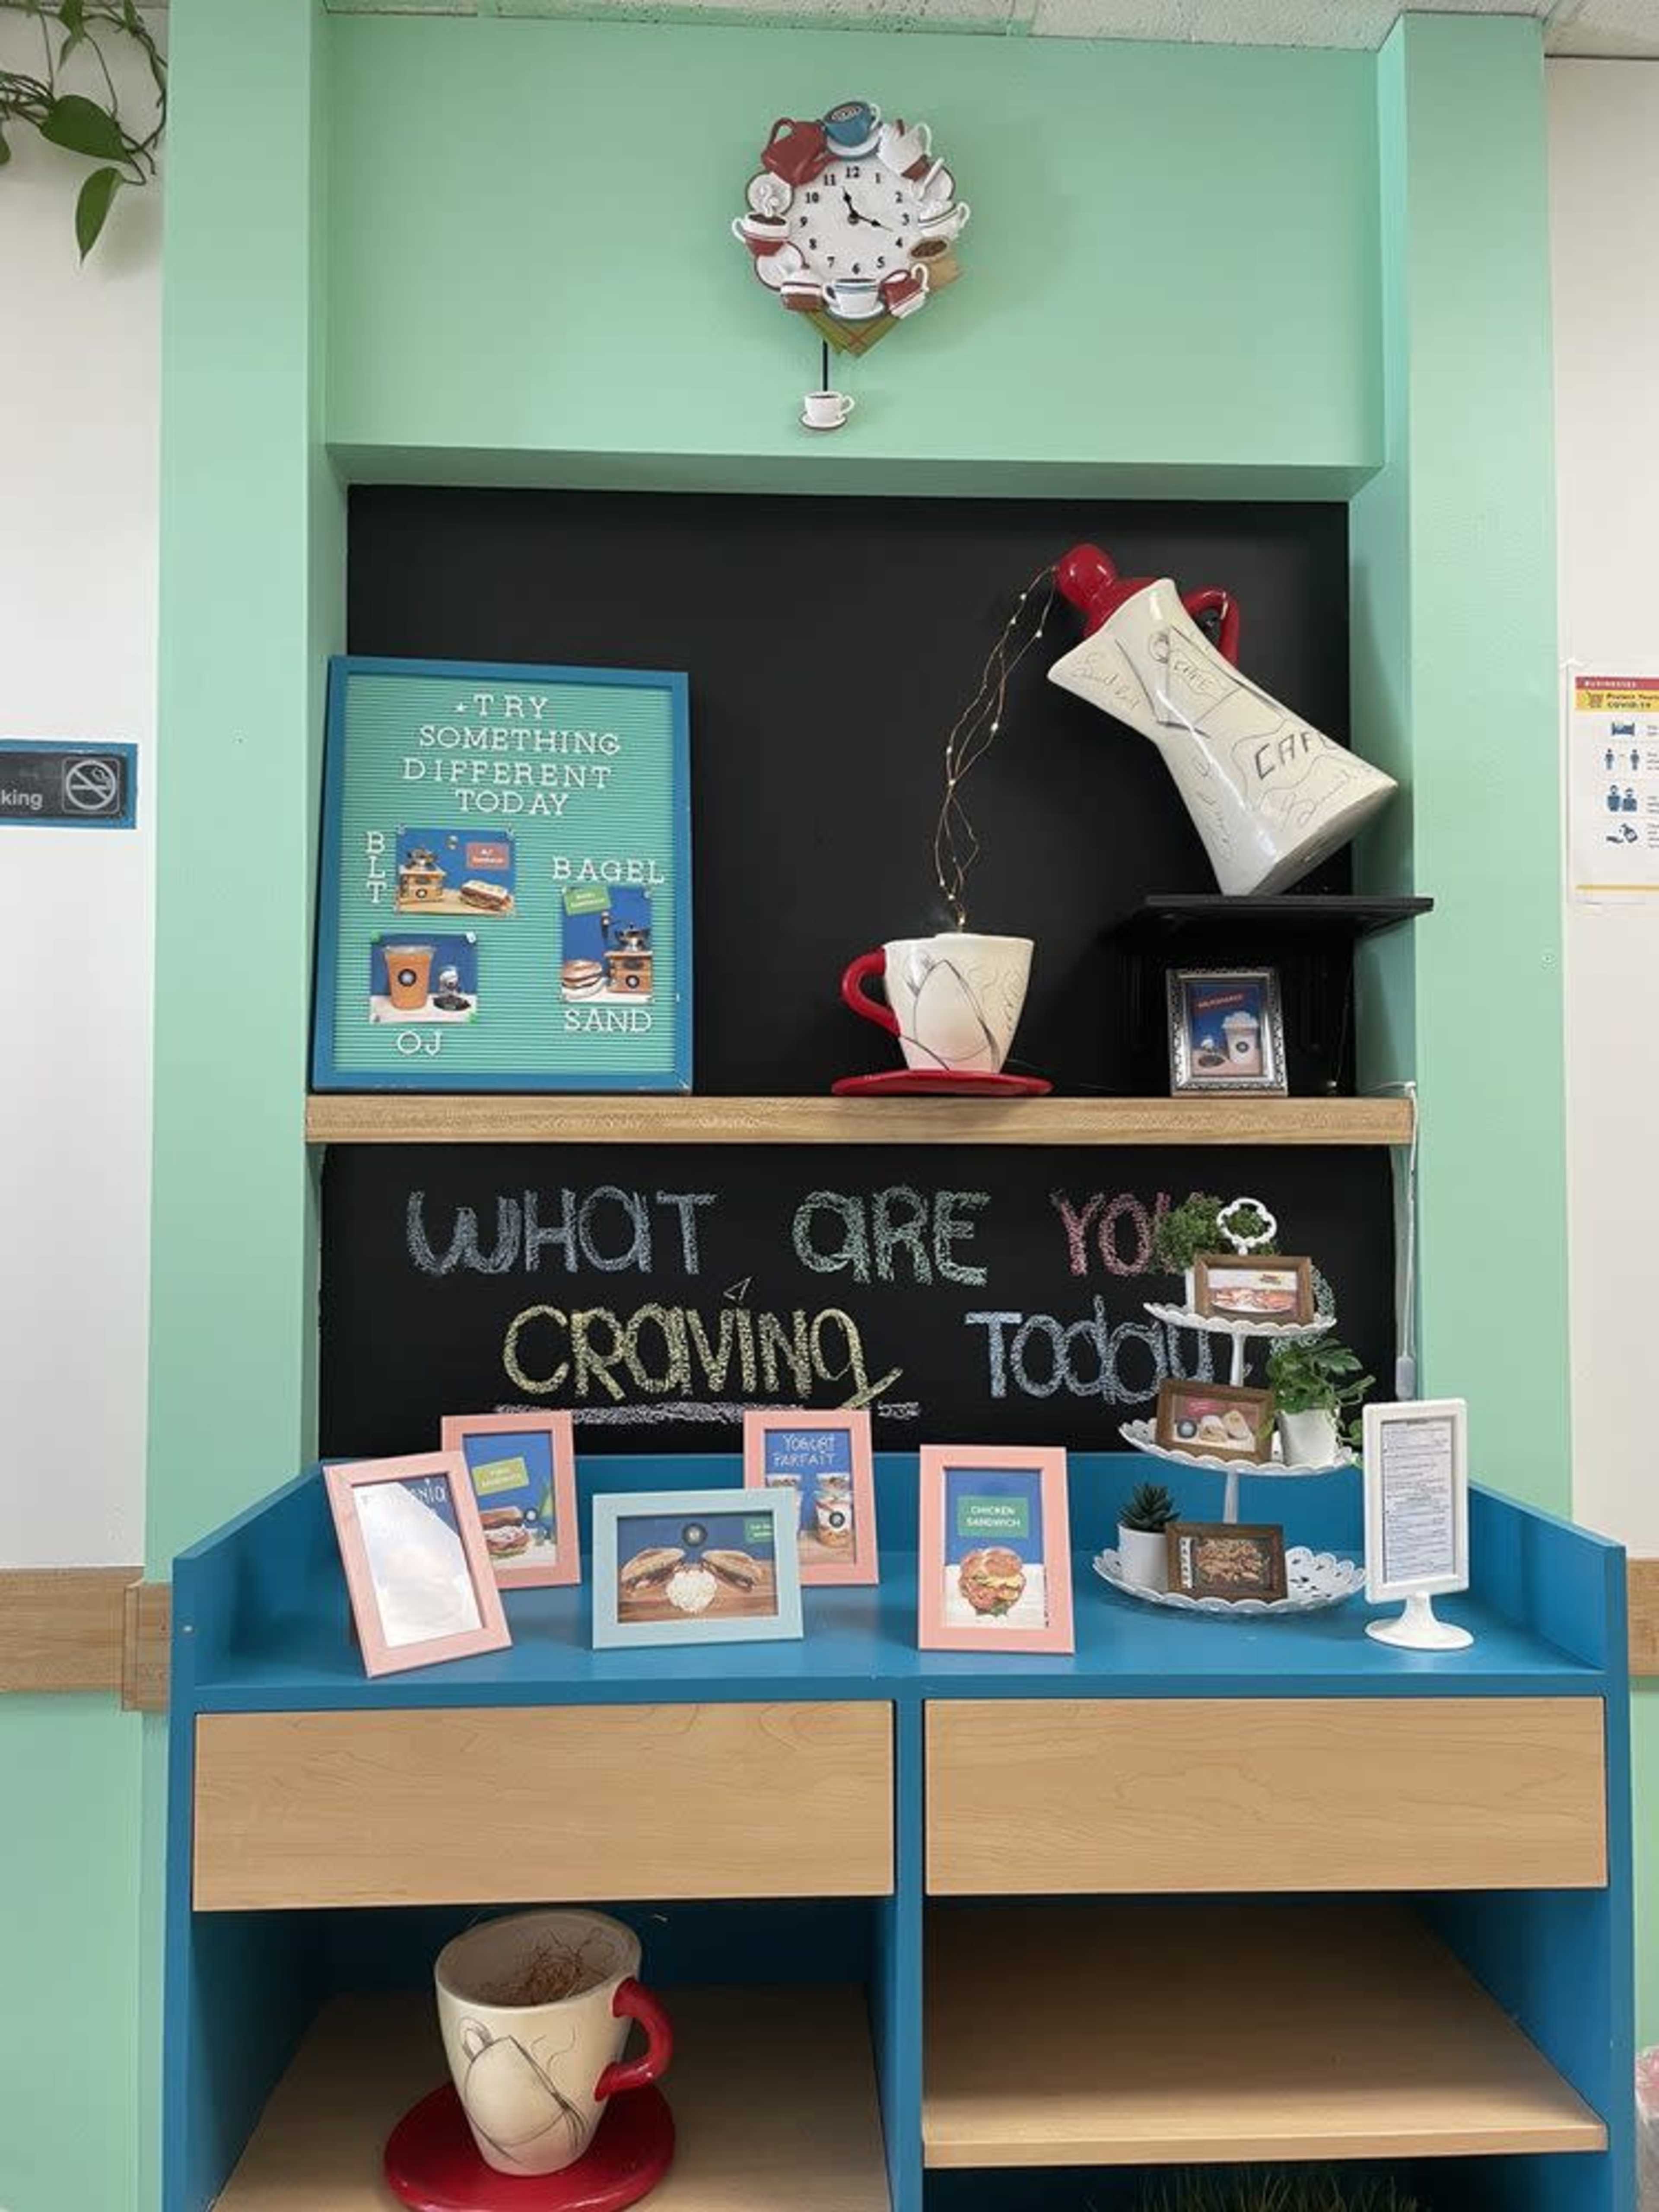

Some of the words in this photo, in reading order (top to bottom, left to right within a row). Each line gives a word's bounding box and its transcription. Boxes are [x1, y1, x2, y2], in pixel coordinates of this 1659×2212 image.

[845, 166, 860, 178] 12
[824, 174, 836, 186] 11
[875, 173, 881, 184] 1
[805, 192, 819, 203] 10
[895, 191, 903, 203] 2
[800, 216, 808, 228] 9
[902, 213, 909, 226] 3
[809, 238, 817, 250] 8
[895, 238, 903, 248] 4
[827, 256, 835, 268] 7
[876, 256, 885, 268] 5
[852, 263, 861, 274] 6
[474, 694, 548, 719] TRY
[419, 726, 620, 756] SOMETHING
[403, 758, 612, 789] DIFFERENT
[455, 790, 569, 815] TODAY
[552, 857, 665, 884] BAGEL
[563, 1009, 653, 1033] SAND
[397, 1031, 443, 1056] OJ
[1049, 1189, 1172, 1278] YO
[970, 1505, 1015, 1516] CHICKEN
[966, 1517, 1021, 1529] SANDWICH
